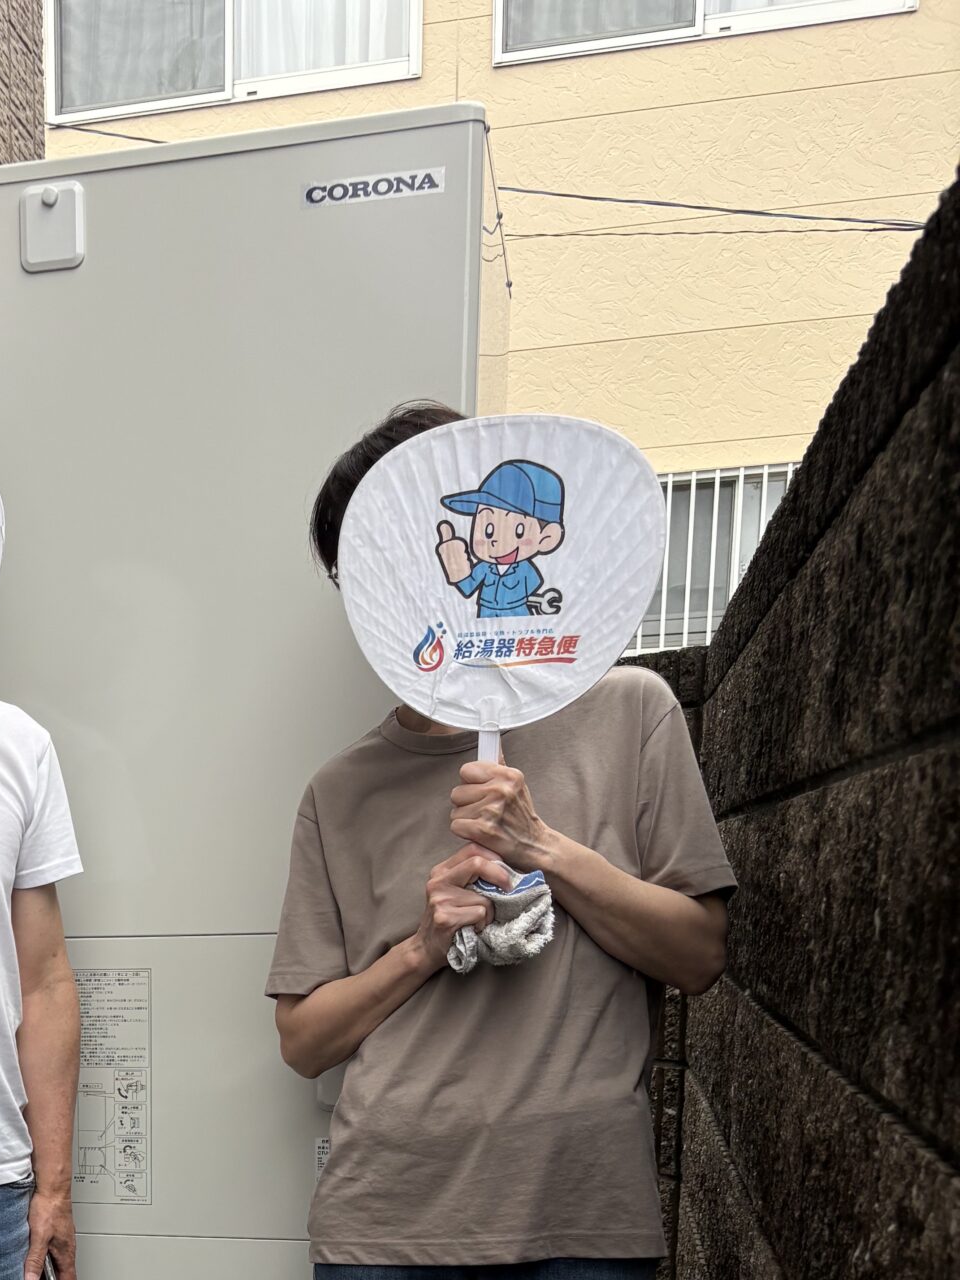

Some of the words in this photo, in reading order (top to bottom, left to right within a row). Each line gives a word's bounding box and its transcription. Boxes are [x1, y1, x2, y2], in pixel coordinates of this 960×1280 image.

[305, 173, 439, 204] CORONA
[453, 635, 581, 660] 給湯器特急便
